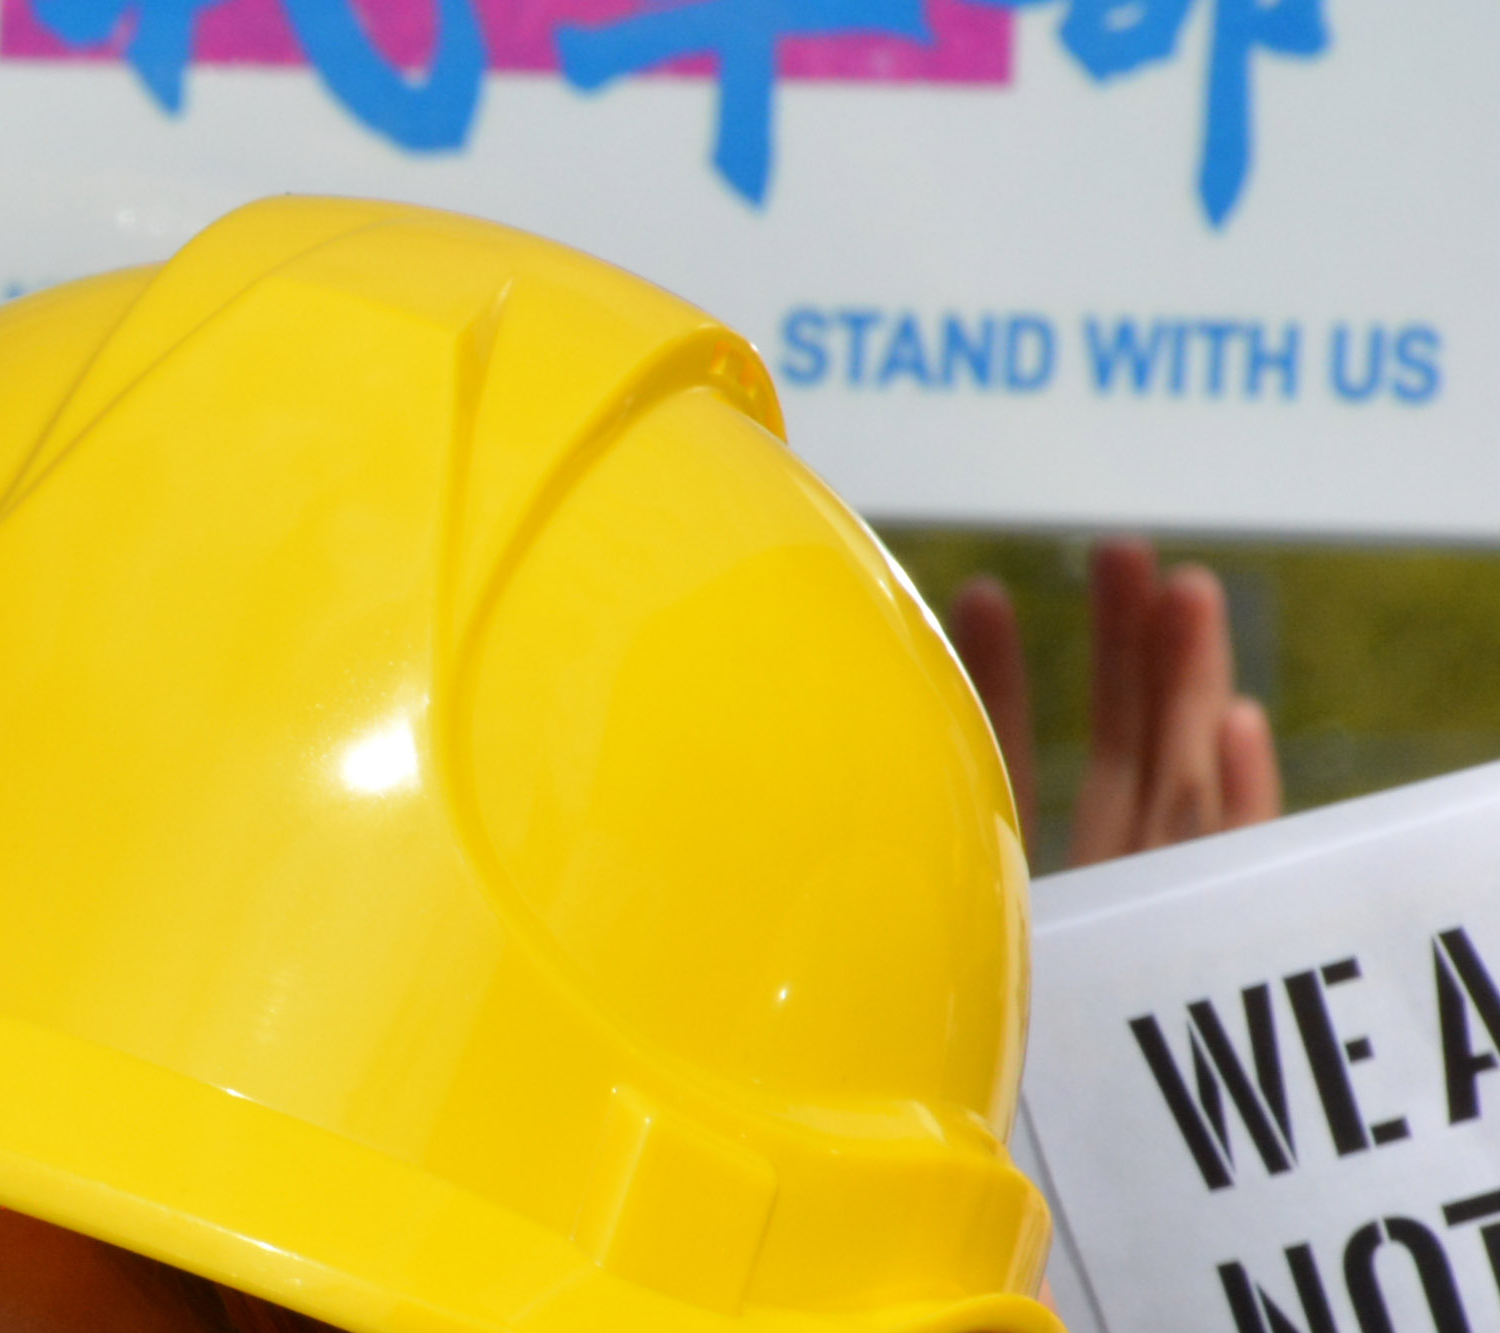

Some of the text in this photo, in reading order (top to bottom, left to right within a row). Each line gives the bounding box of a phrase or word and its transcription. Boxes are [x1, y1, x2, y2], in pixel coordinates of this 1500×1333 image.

[781, 307, 1445, 402] STAND WITH US
[1127, 955, 1411, 1192] WE
